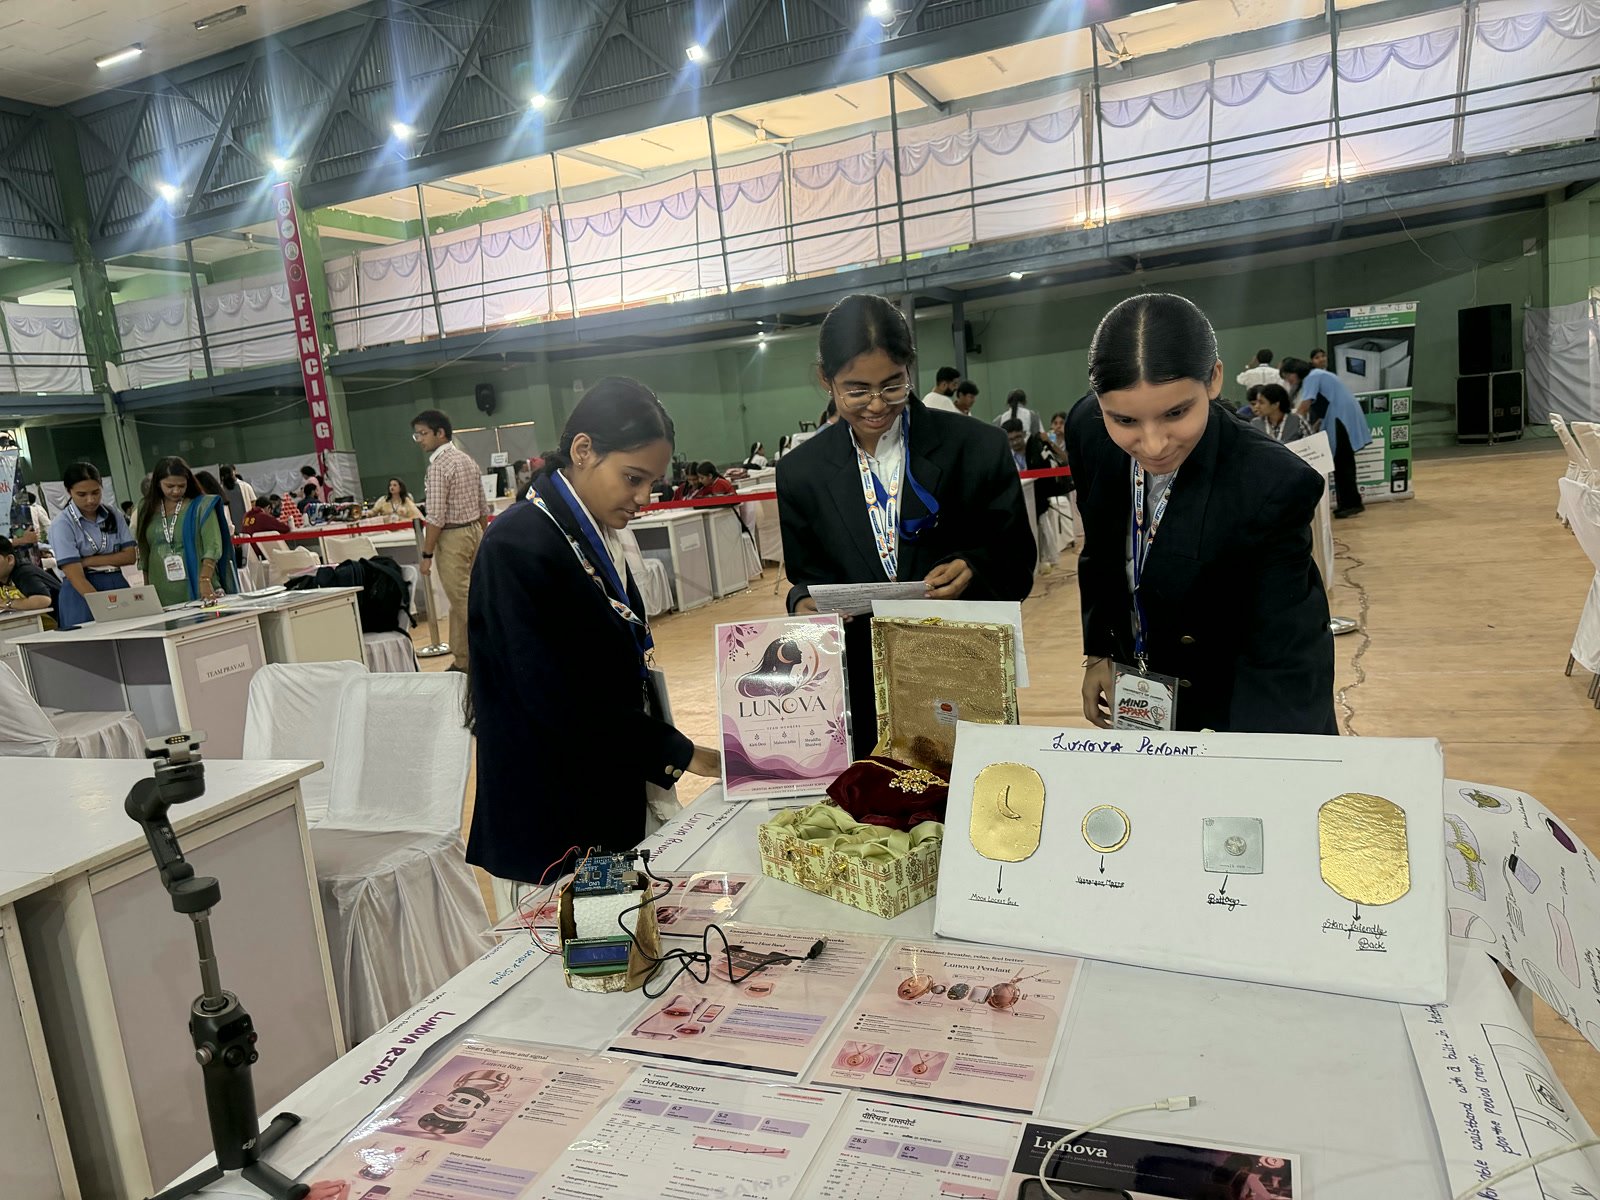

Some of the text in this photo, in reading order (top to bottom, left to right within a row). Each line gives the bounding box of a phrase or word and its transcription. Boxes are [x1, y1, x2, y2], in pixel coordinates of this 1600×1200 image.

[295, 293, 330, 439] FENCING
[206, 668, 223, 679] TEAM
[739, 695, 827, 718] LUNOVA
[1119, 698, 1148, 708] MIND
[1118, 706, 1151, 720] SPARK
[943, 961, 1011, 974] Lunova Pendant
[359, 1011, 456, 1084] LUNOVA RING
[481, 1060, 506, 1069] Lunova
[642, 1077, 706, 1092] Period Passport
[862, 1112, 916, 1127] पीरियड पासपोर्ट
